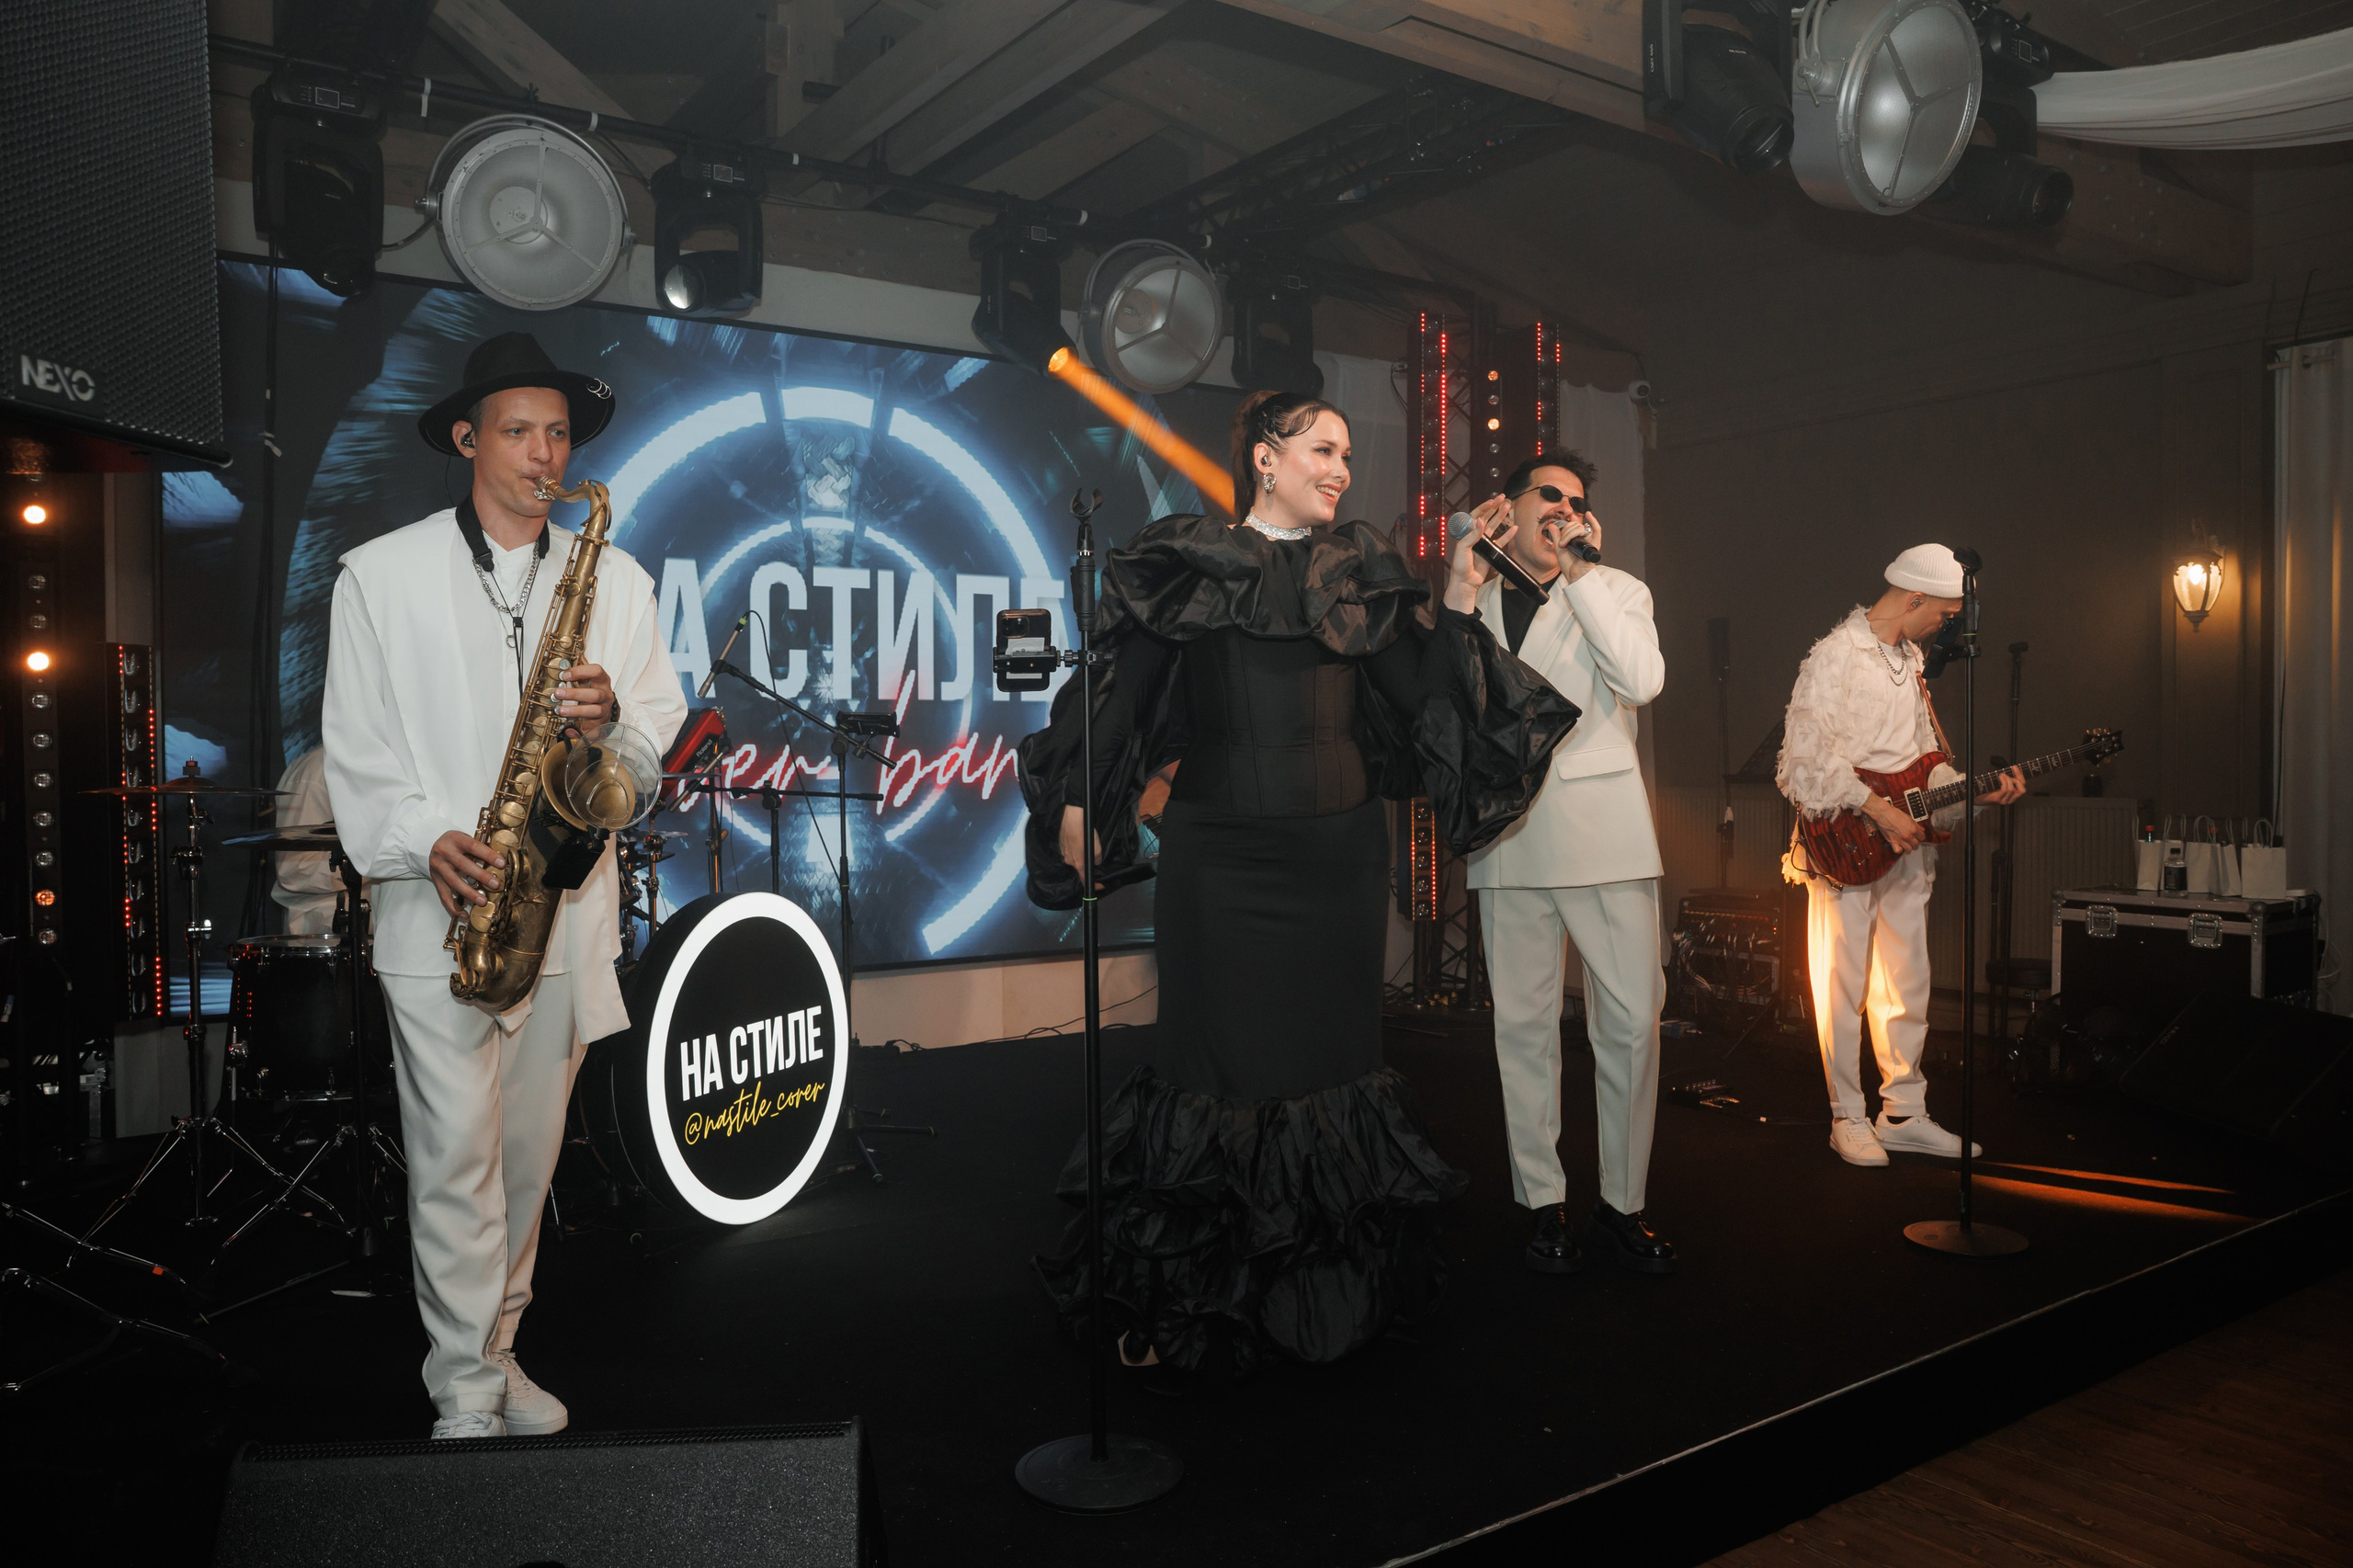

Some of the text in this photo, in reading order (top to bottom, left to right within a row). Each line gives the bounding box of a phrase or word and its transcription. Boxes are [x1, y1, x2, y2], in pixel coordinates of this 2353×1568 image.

[21, 354, 96, 402] NEXO
[654, 557, 717, 699] А
[695, 738, 713, 757] Roland
[876, 669, 1019, 815] ban
[680, 1006, 824, 1101] НА СТИЛЕ
[685, 1081, 825, 1145] @nastile_cover
